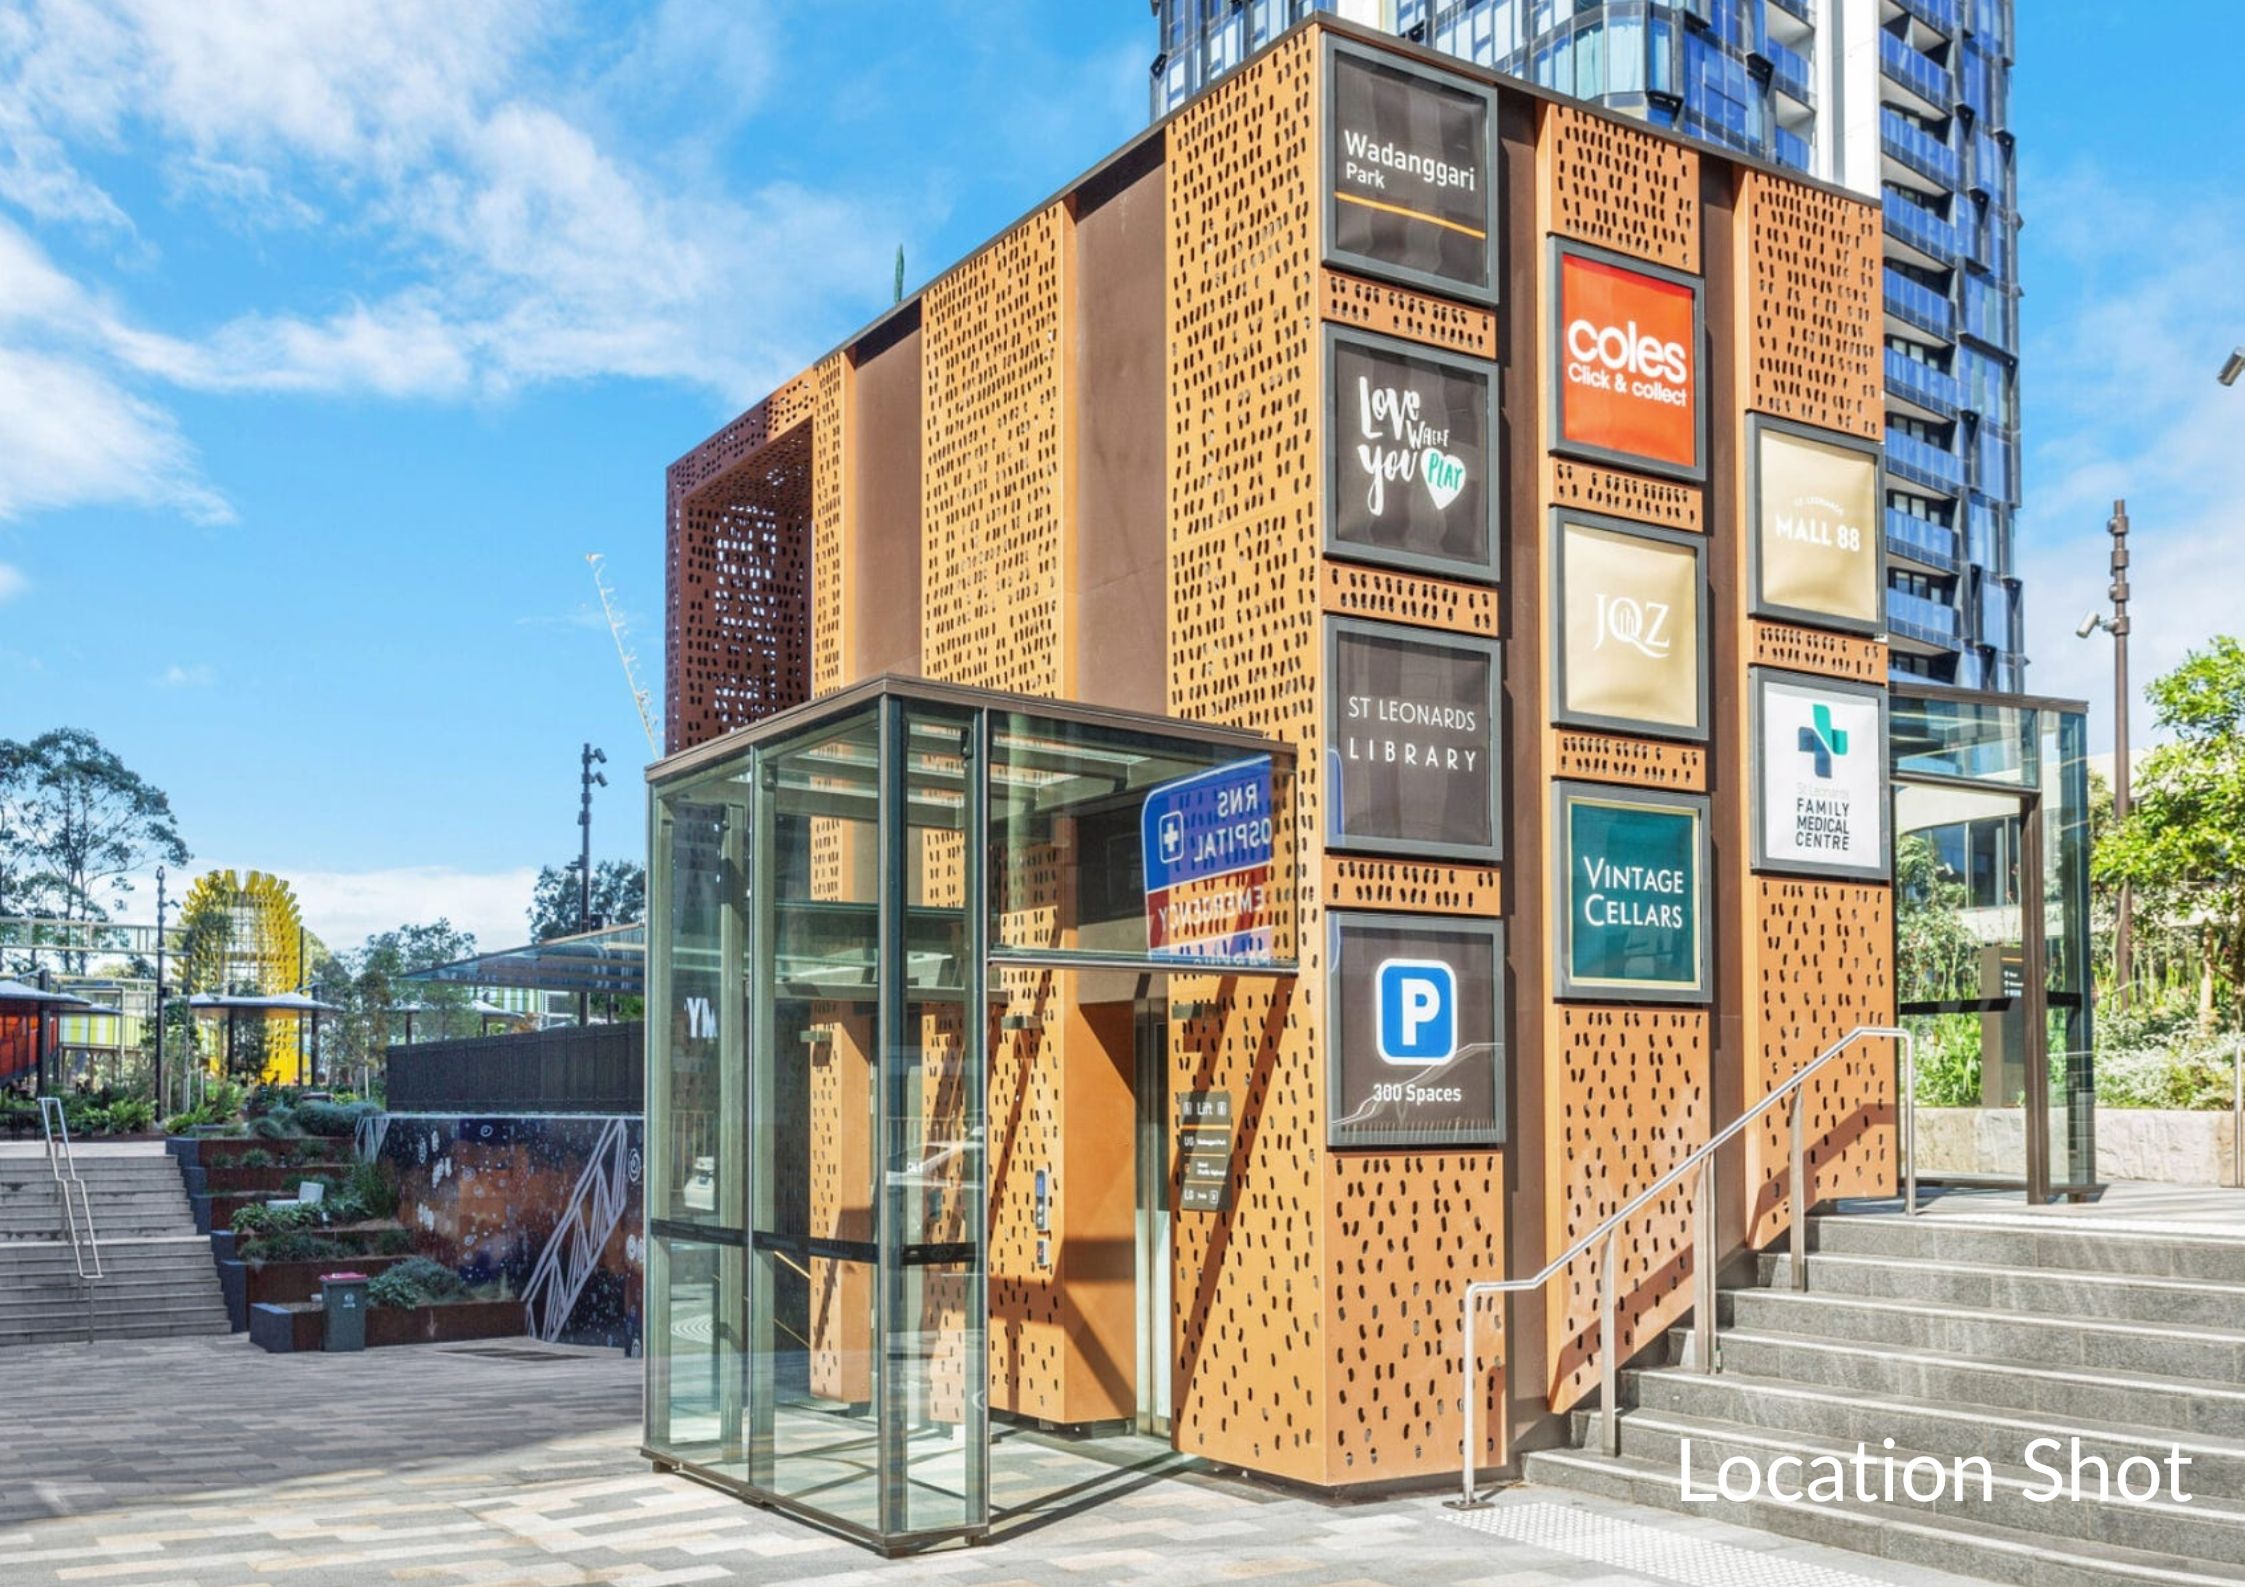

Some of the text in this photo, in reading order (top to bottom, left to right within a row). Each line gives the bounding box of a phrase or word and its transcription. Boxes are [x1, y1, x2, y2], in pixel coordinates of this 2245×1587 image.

[1344, 128, 1475, 191] Wadanggari
[1346, 161, 1385, 189] Park
[1567, 319, 1688, 385] coles
[1567, 361, 1687, 407] Click & collect
[1359, 375, 1421, 441] Love
[1356, 444, 1464, 517] you PLAY
[1775, 512, 1861, 553] MALL 88
[1592, 592, 1671, 659] JQZ
[1348, 696, 1477, 732] ST LEONARDS
[1350, 737, 1477, 772] LIBRARY
[1796, 797, 1850, 817] FAMILY
[1796, 815, 1850, 835] MEDICAL
[1795, 831, 1850, 851] CENTRE
[1401, 977, 1441, 1046] P
[1372, 1082, 1462, 1107] 300 Spaces
